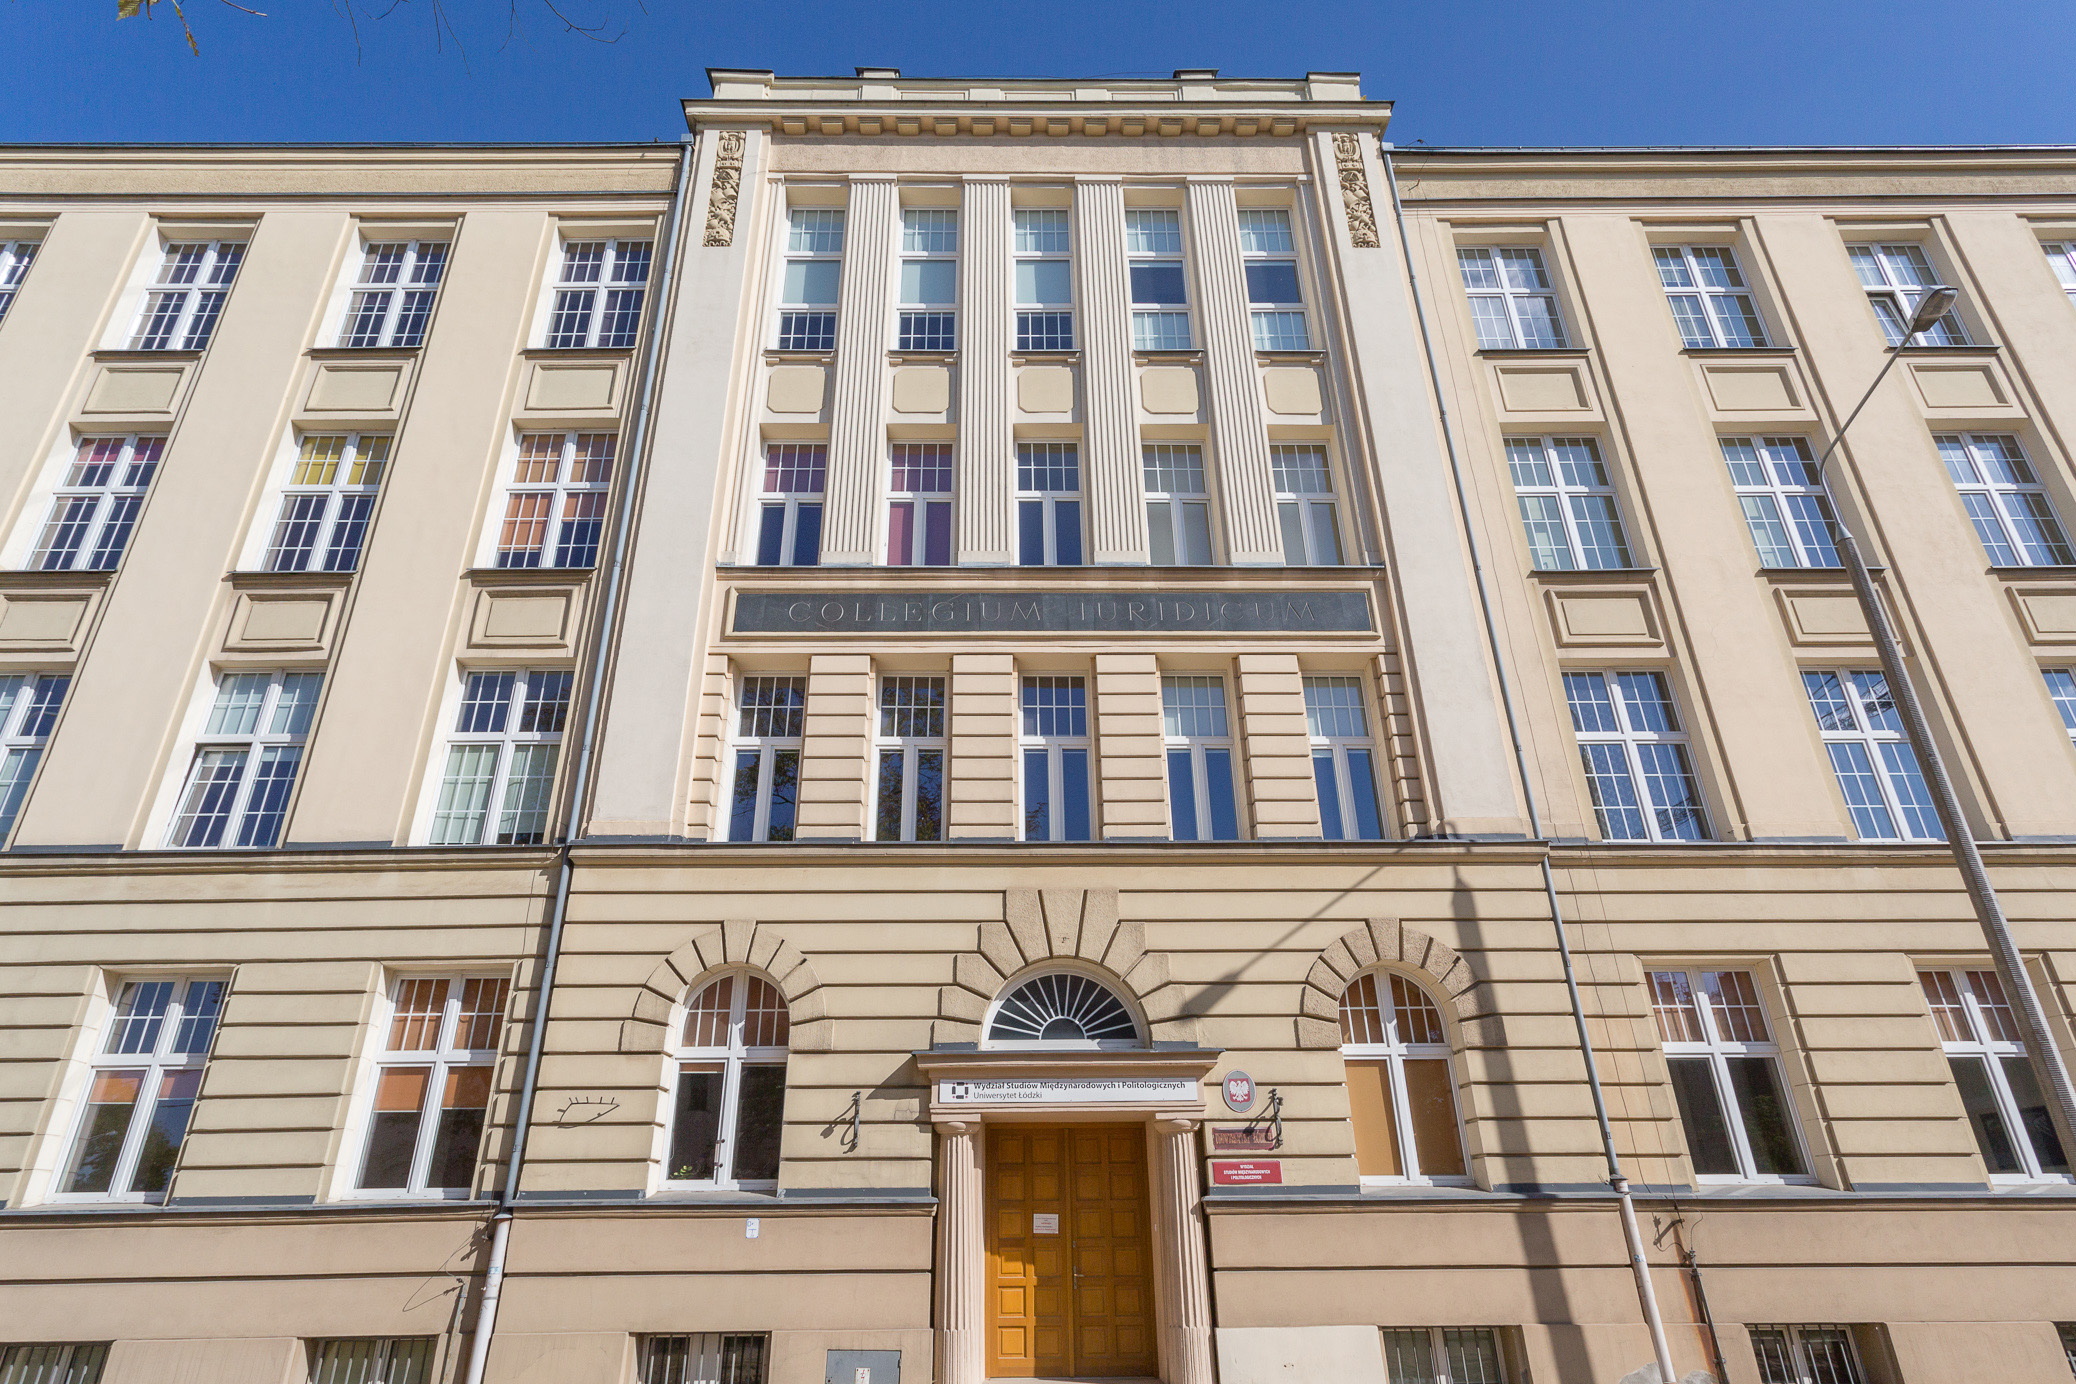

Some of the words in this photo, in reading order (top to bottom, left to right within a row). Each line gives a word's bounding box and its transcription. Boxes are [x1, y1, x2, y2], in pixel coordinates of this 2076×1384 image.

[788, 601, 1041, 622] COLLEGIUM
[1080, 601, 1316, 622] IURIDICUM
[973, 1082, 1005, 1091] Wydział
[1006, 1081, 1038, 1090] Studiów
[1039, 1081, 1116, 1091] Międzynarodowych
[1122, 1081, 1186, 1091] Politologicznych
[973, 1091, 1017, 1100] Uniwersytet
[1018, 1091, 1043, 1099] Łódzki
